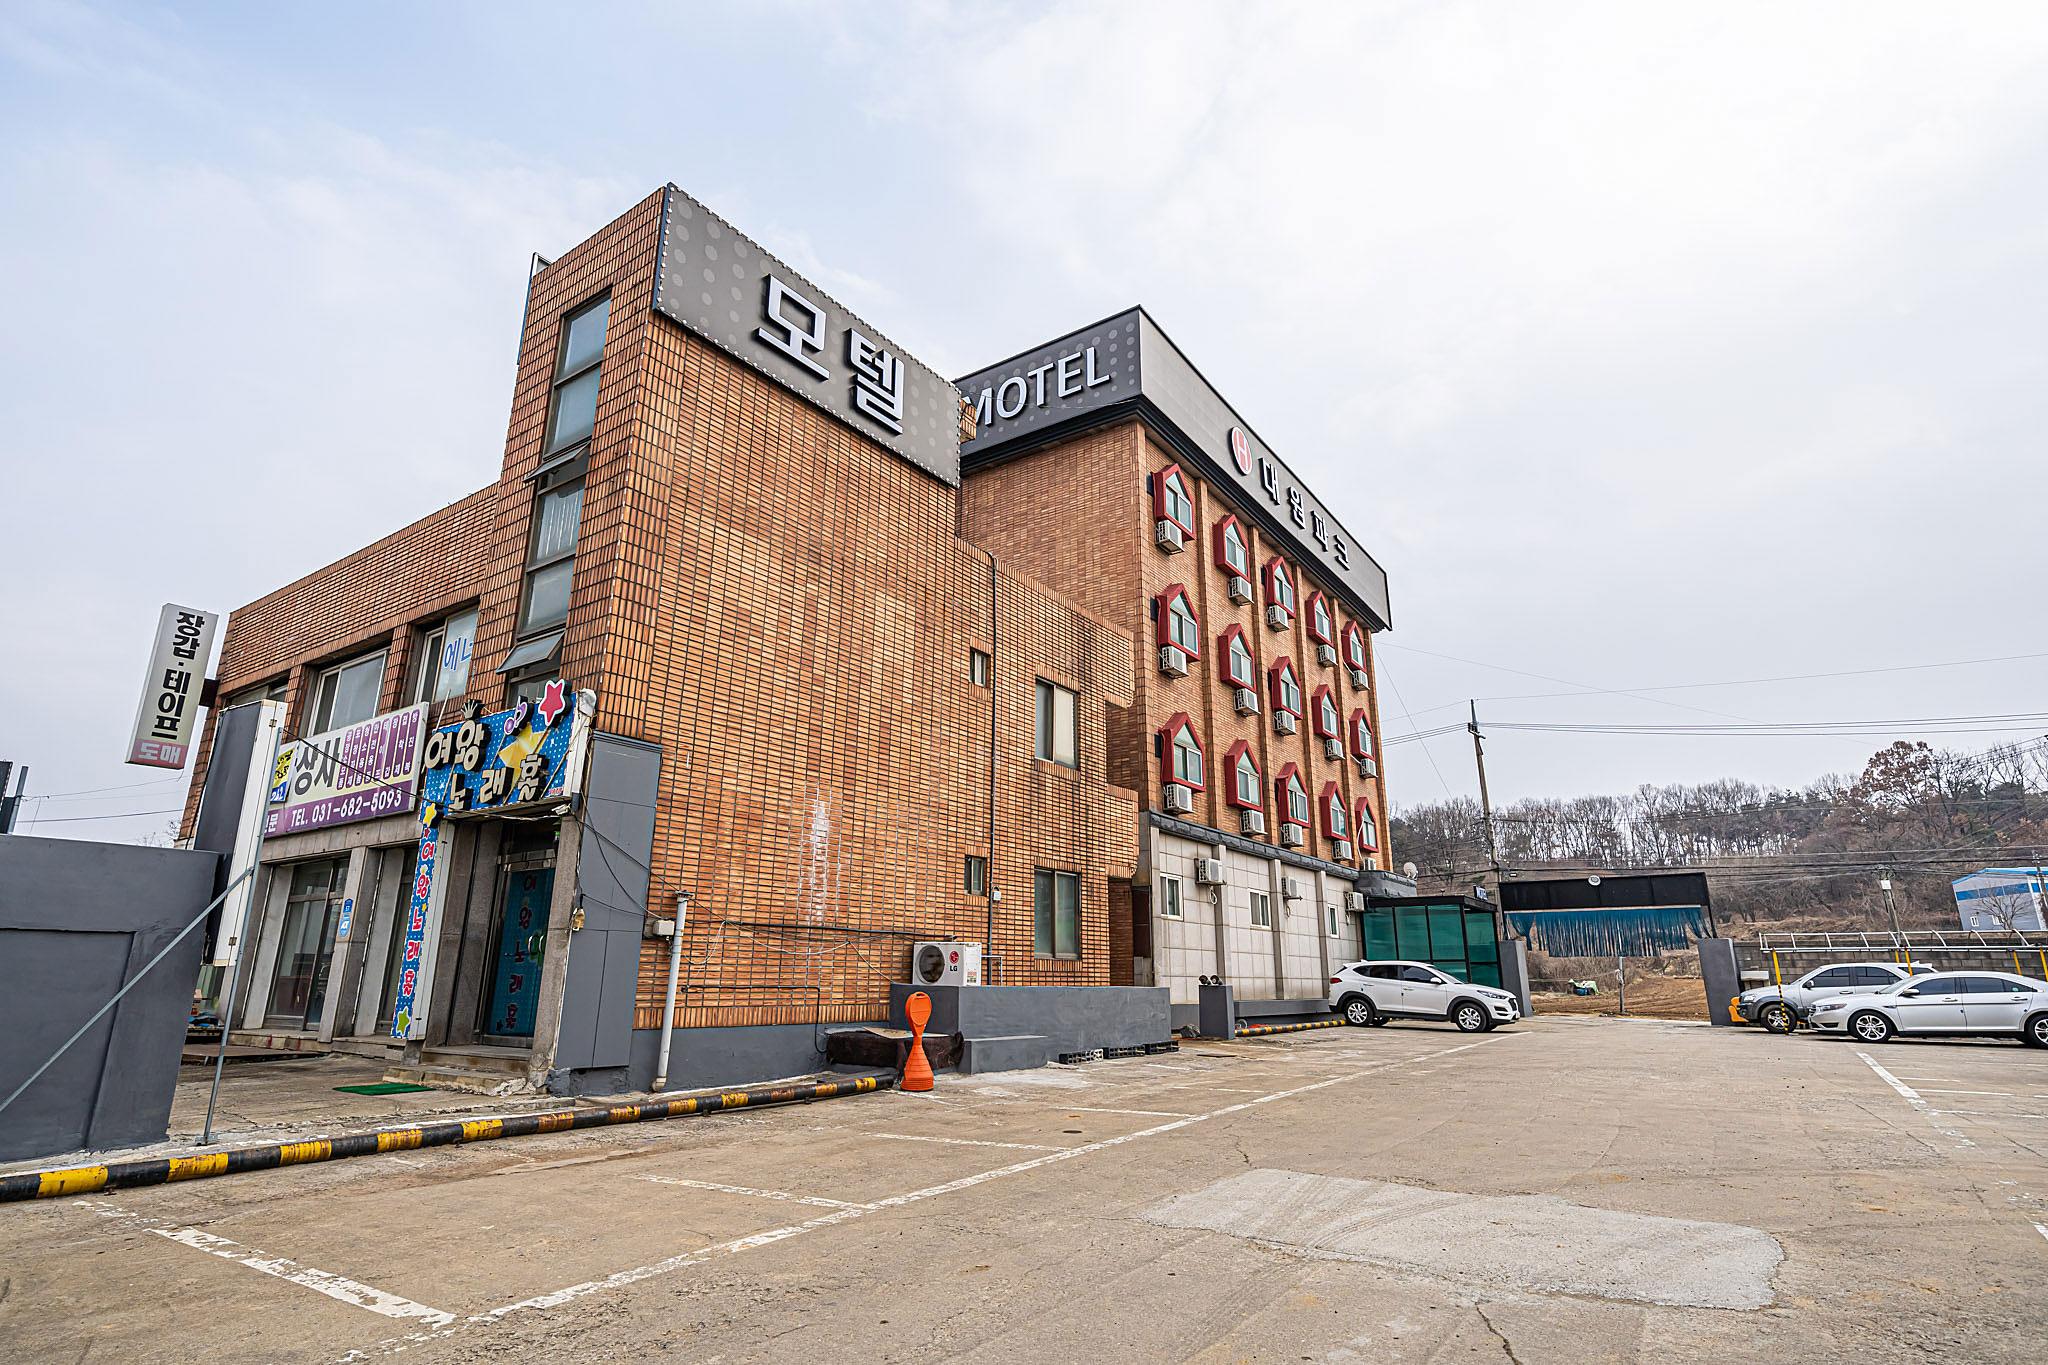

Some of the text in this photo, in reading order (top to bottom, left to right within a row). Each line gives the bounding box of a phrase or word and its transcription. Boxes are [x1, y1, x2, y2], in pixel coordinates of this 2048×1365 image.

[758, 273, 905, 434] 모텔
[962, 347, 1111, 426] MOTEL
[1257, 457, 1351, 571] 대원파크
[138, 741, 181, 764] 도매
[424, 719, 486, 771] 여왕
[291, 807, 308, 828] TEL.
[312, 788, 402, 823] 031-682-5093
[448, 753, 543, 812] 노래홀
